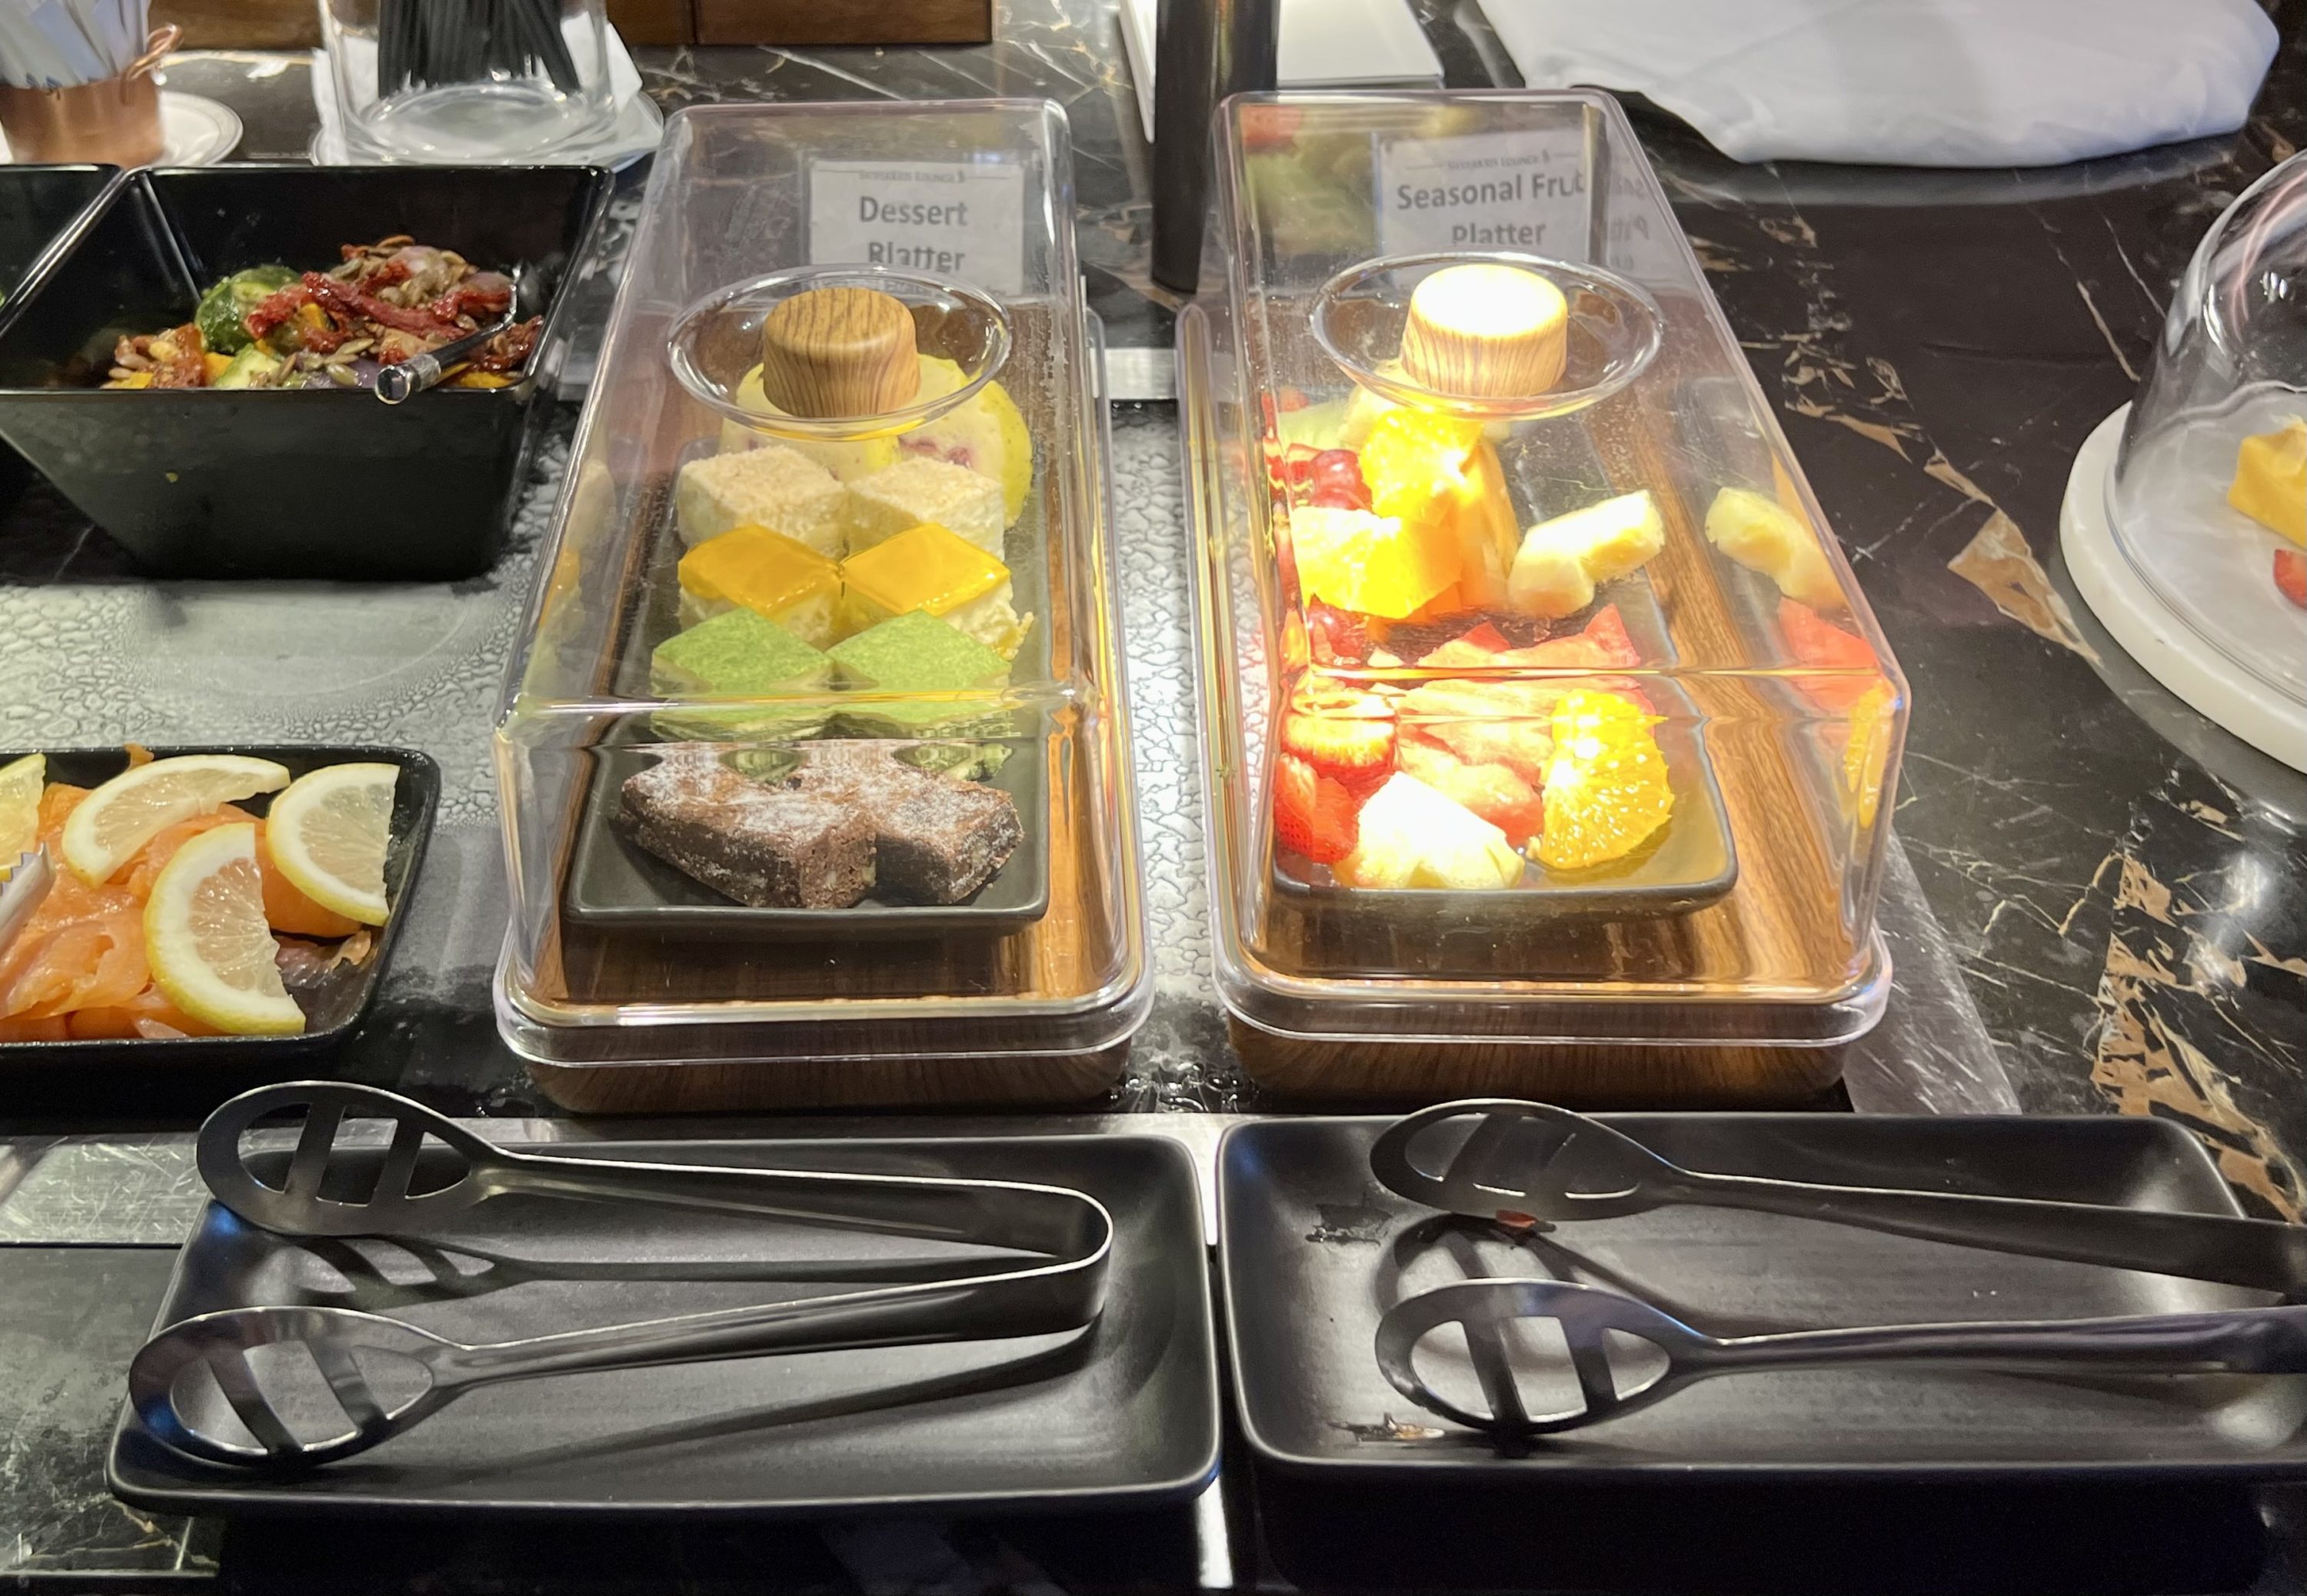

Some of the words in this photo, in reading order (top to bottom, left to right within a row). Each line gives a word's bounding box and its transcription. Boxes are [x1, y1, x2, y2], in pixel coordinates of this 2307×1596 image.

[1397, 174, 1522, 210] Seasonal
[1532, 168, 1584, 199] Frut
[859, 195, 969, 226] Dessert
